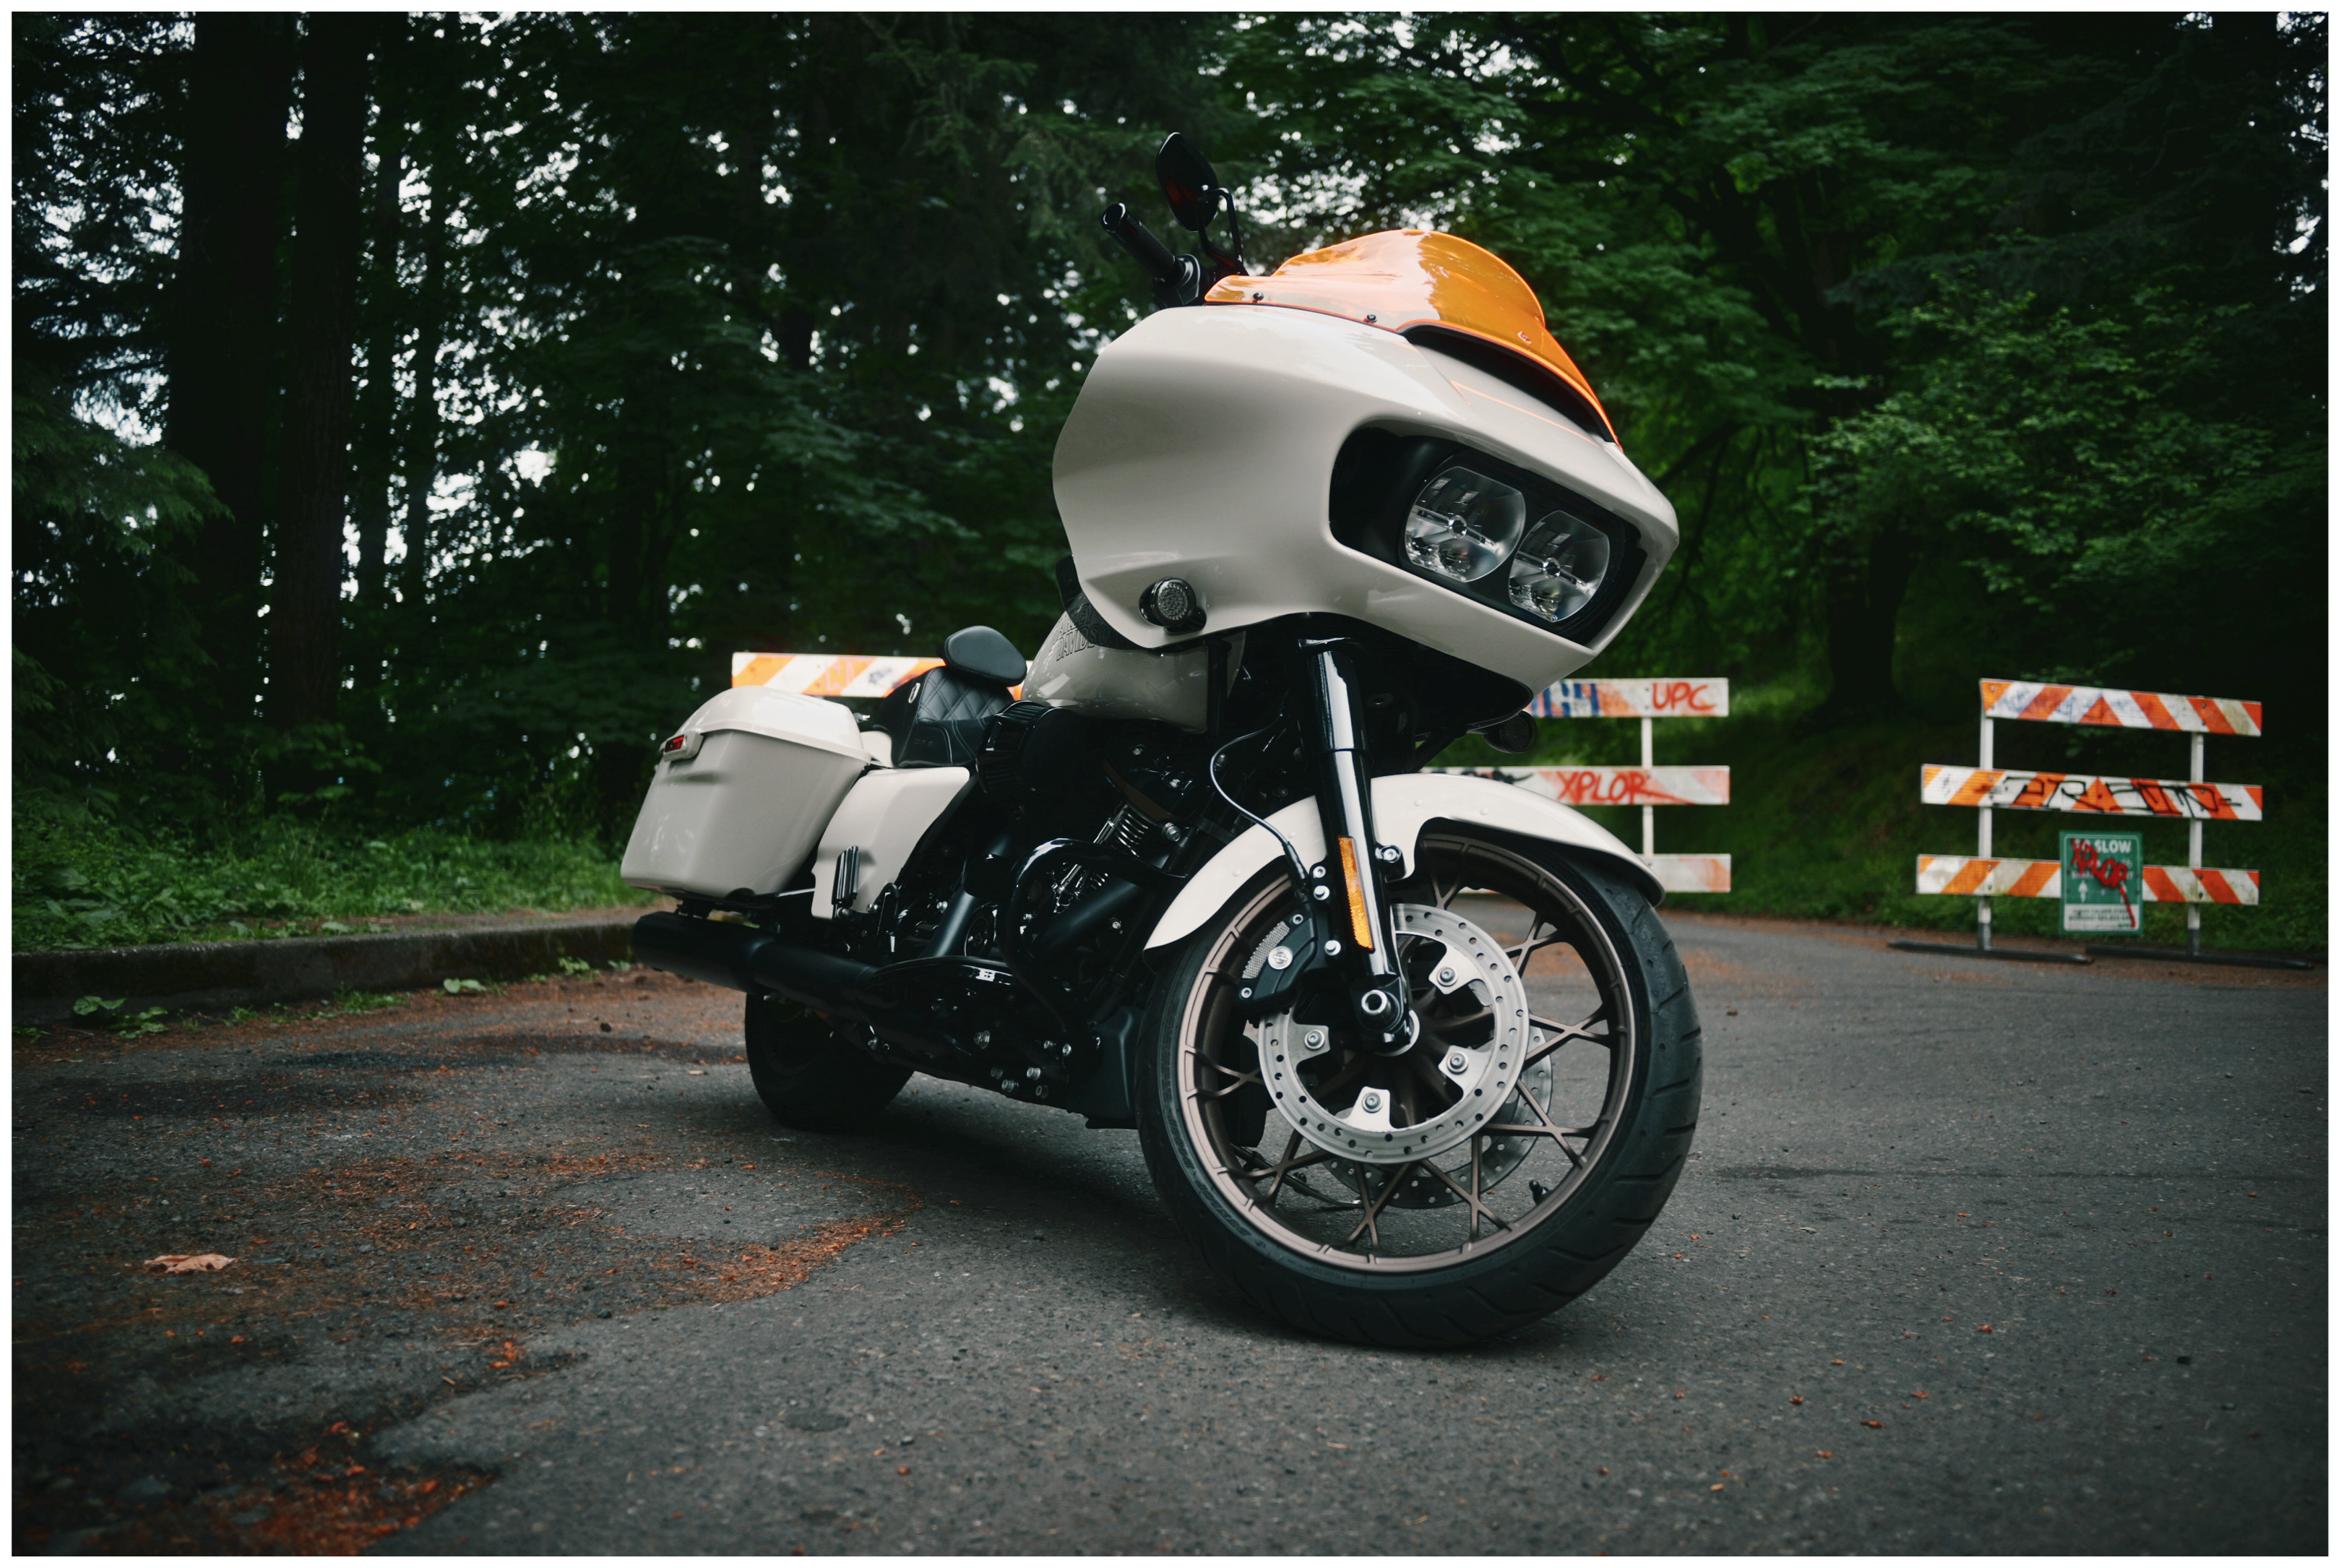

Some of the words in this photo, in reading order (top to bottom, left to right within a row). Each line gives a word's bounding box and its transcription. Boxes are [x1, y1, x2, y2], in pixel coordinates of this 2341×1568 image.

[1652, 682, 1717, 710] UPC
[2095, 839, 2132, 853] SLOW
[1194, 1179, 1251, 1236] DUNLOP
